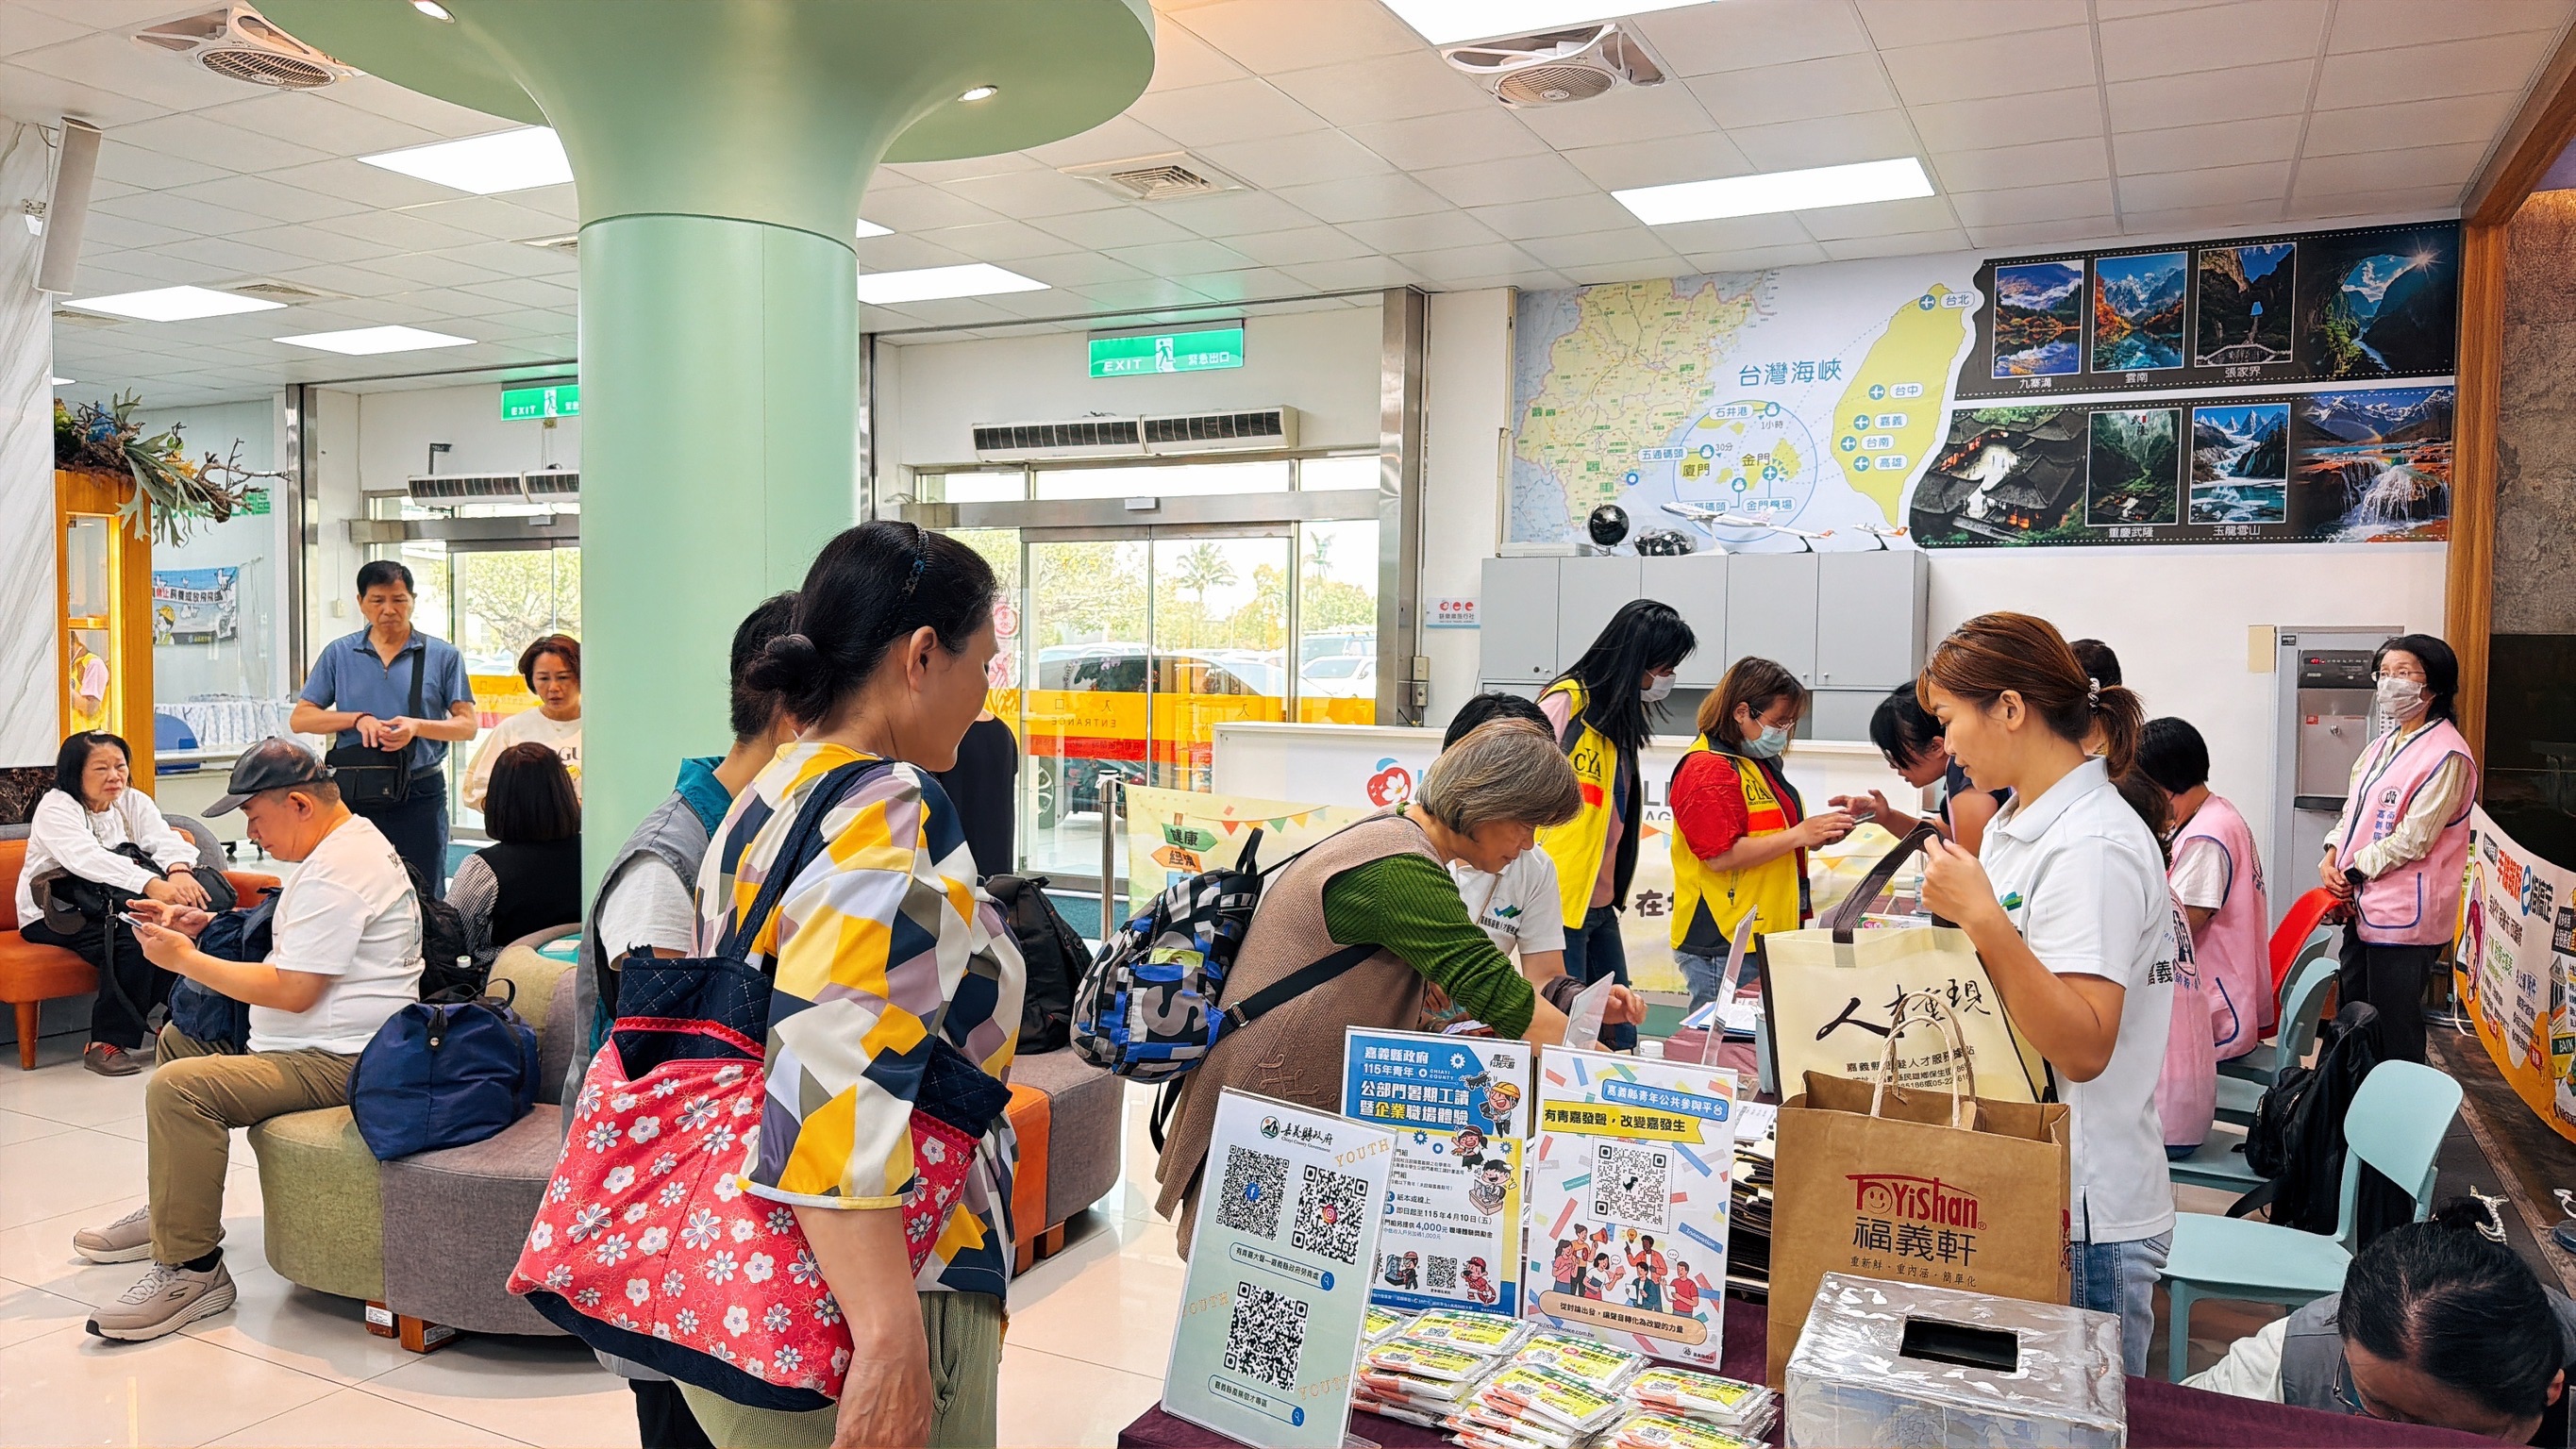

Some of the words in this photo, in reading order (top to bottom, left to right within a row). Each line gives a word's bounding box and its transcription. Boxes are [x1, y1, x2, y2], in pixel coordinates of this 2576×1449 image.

[1946, 294, 1969, 306] 台北
[1104, 359, 1142, 372] EXIT
[1188, 352, 1229, 365] 緊急出口
[1739, 358, 1842, 387] 台灣海峽
[2125, 373, 2149, 383] 雲南
[2225, 366, 2261, 378] 張家界
[1895, 385, 1918, 396] 台中
[511, 406, 536, 415] EXIT
[1715, 407, 1748, 417] 石井港
[1761, 421, 1783, 429] 1小時
[1880, 415, 1902, 426] 嘉義
[1866, 437, 1890, 448] 台南
[1642, 449, 1684, 459] 五通碼頭
[1742, 453, 1770, 466] 金門
[1682, 463, 1710, 477] 廈門
[1880, 457, 1902, 469] 高雄
[1574, 748, 1601, 777] CYA
[1746, 779, 1773, 801] CYA
[1170, 828, 1198, 846] 健康
[1169, 850, 1196, 868] 經濟
[1364, 1046, 1430, 1064] 嘉義縣政府
[1363, 1063, 1414, 1077] 115年青年
[1361, 1080, 1470, 1107] 公部門暑期工讀
[1607, 1084, 1724, 1115] 嘉義縣青年公共參與平台
[1360, 1100, 1469, 1124] 暨企業職場體驗
[1280, 1122, 1333, 1146] 嘉義縣政府
[1334, 1138, 1390, 1167] YOUTH
[1686, 1227, 1715, 1248] Innovation
[1853, 1216, 1977, 1267] 福義軒
